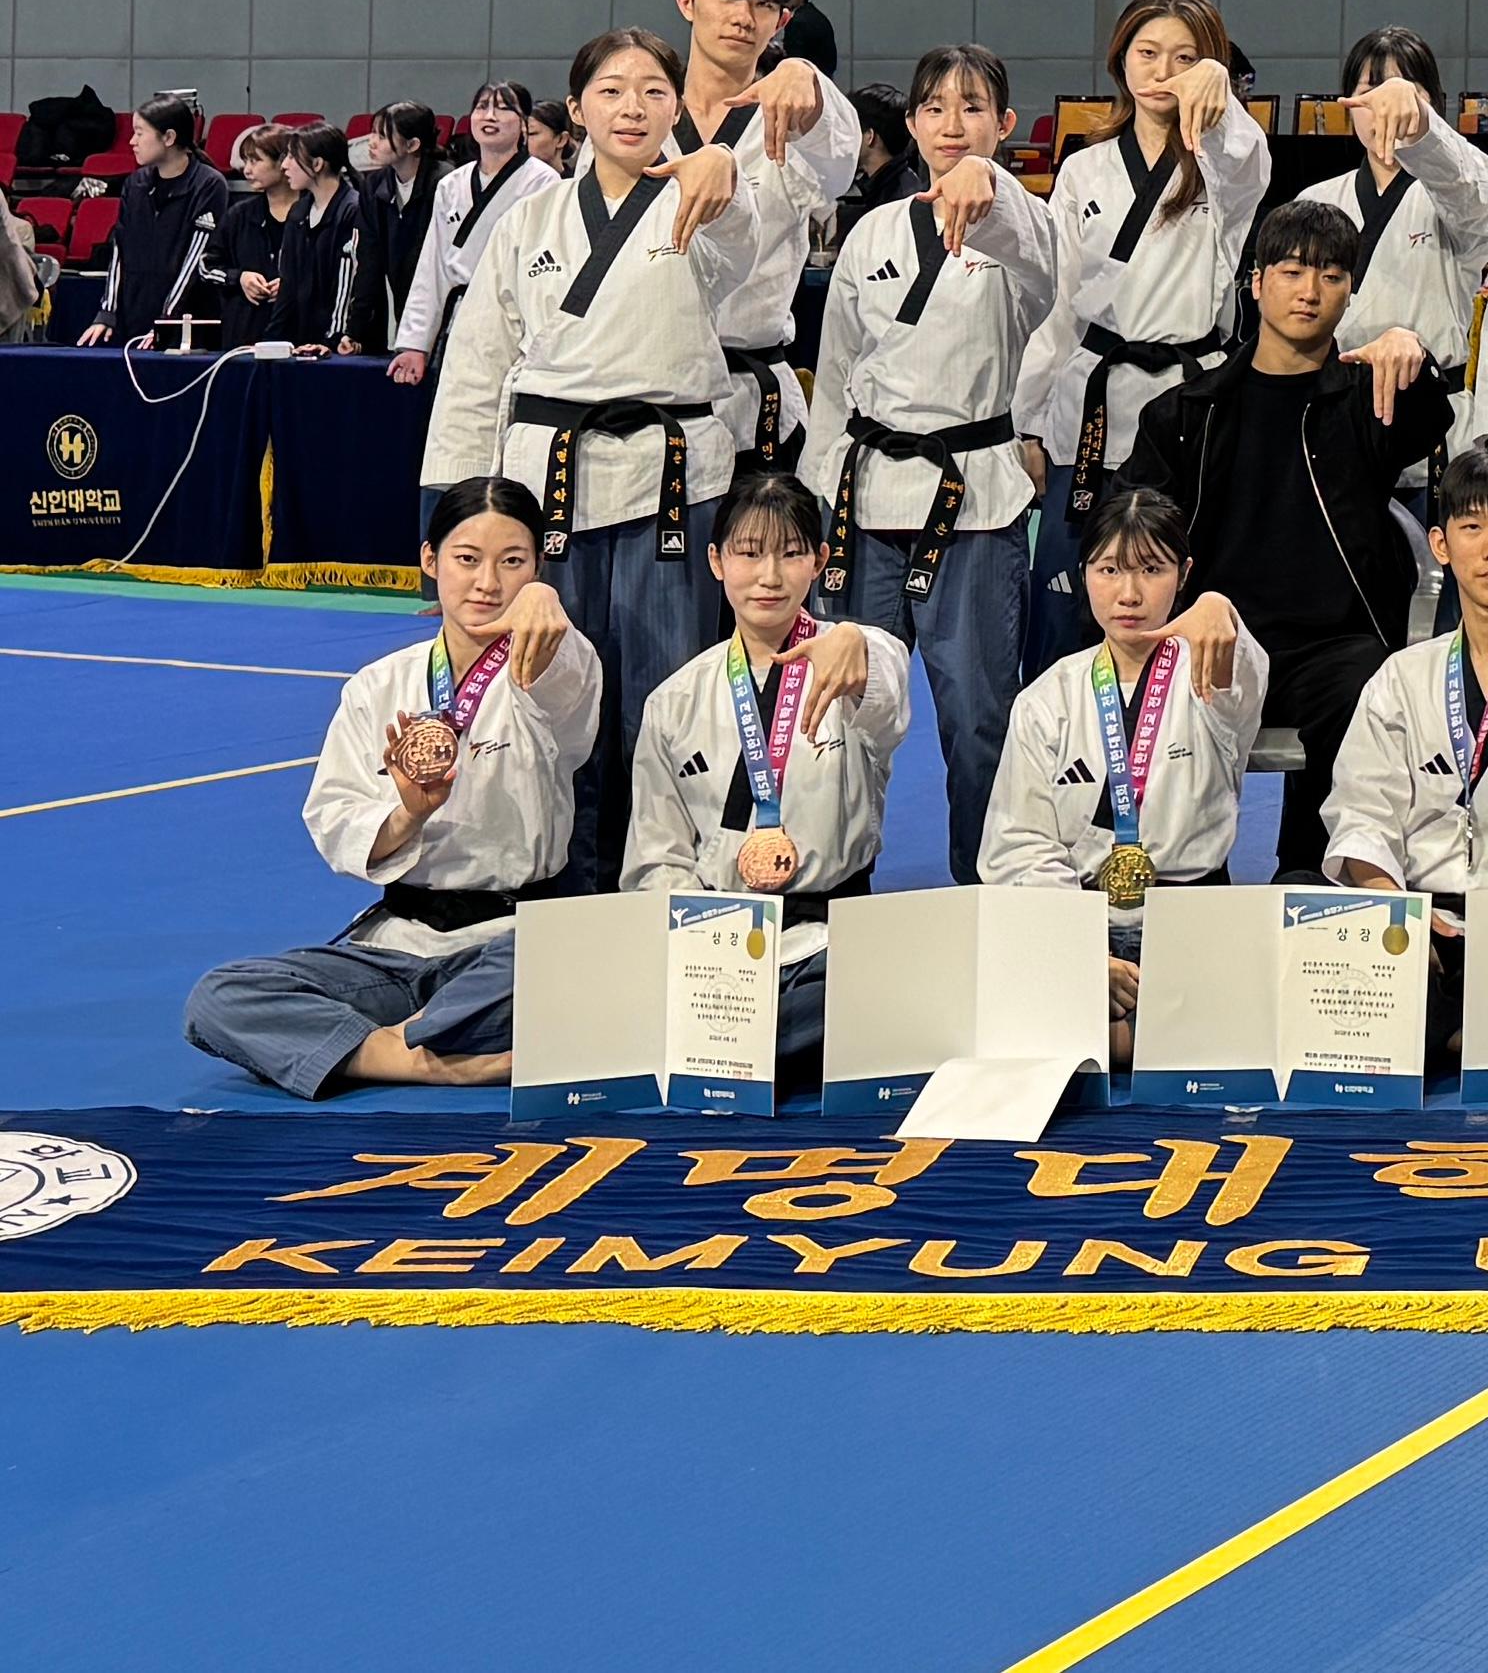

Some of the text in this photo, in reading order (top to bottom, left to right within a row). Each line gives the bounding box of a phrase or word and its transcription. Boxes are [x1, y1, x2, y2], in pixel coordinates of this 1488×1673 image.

[29, 489, 122, 515] 신한대학교
[736, 699, 764, 762] 신한대학교
[770, 691, 795, 758] 신한대학교
[1444, 677, 1466, 739] 신한대학교
[1102, 709, 1126, 774] 신한대학교
[1130, 710, 1157, 778] 신한대학교
[753, 769, 773, 802] 제5회
[1114, 783, 1131, 816] 제5회
[202, 1234, 1372, 1279] KEIMYUNG
